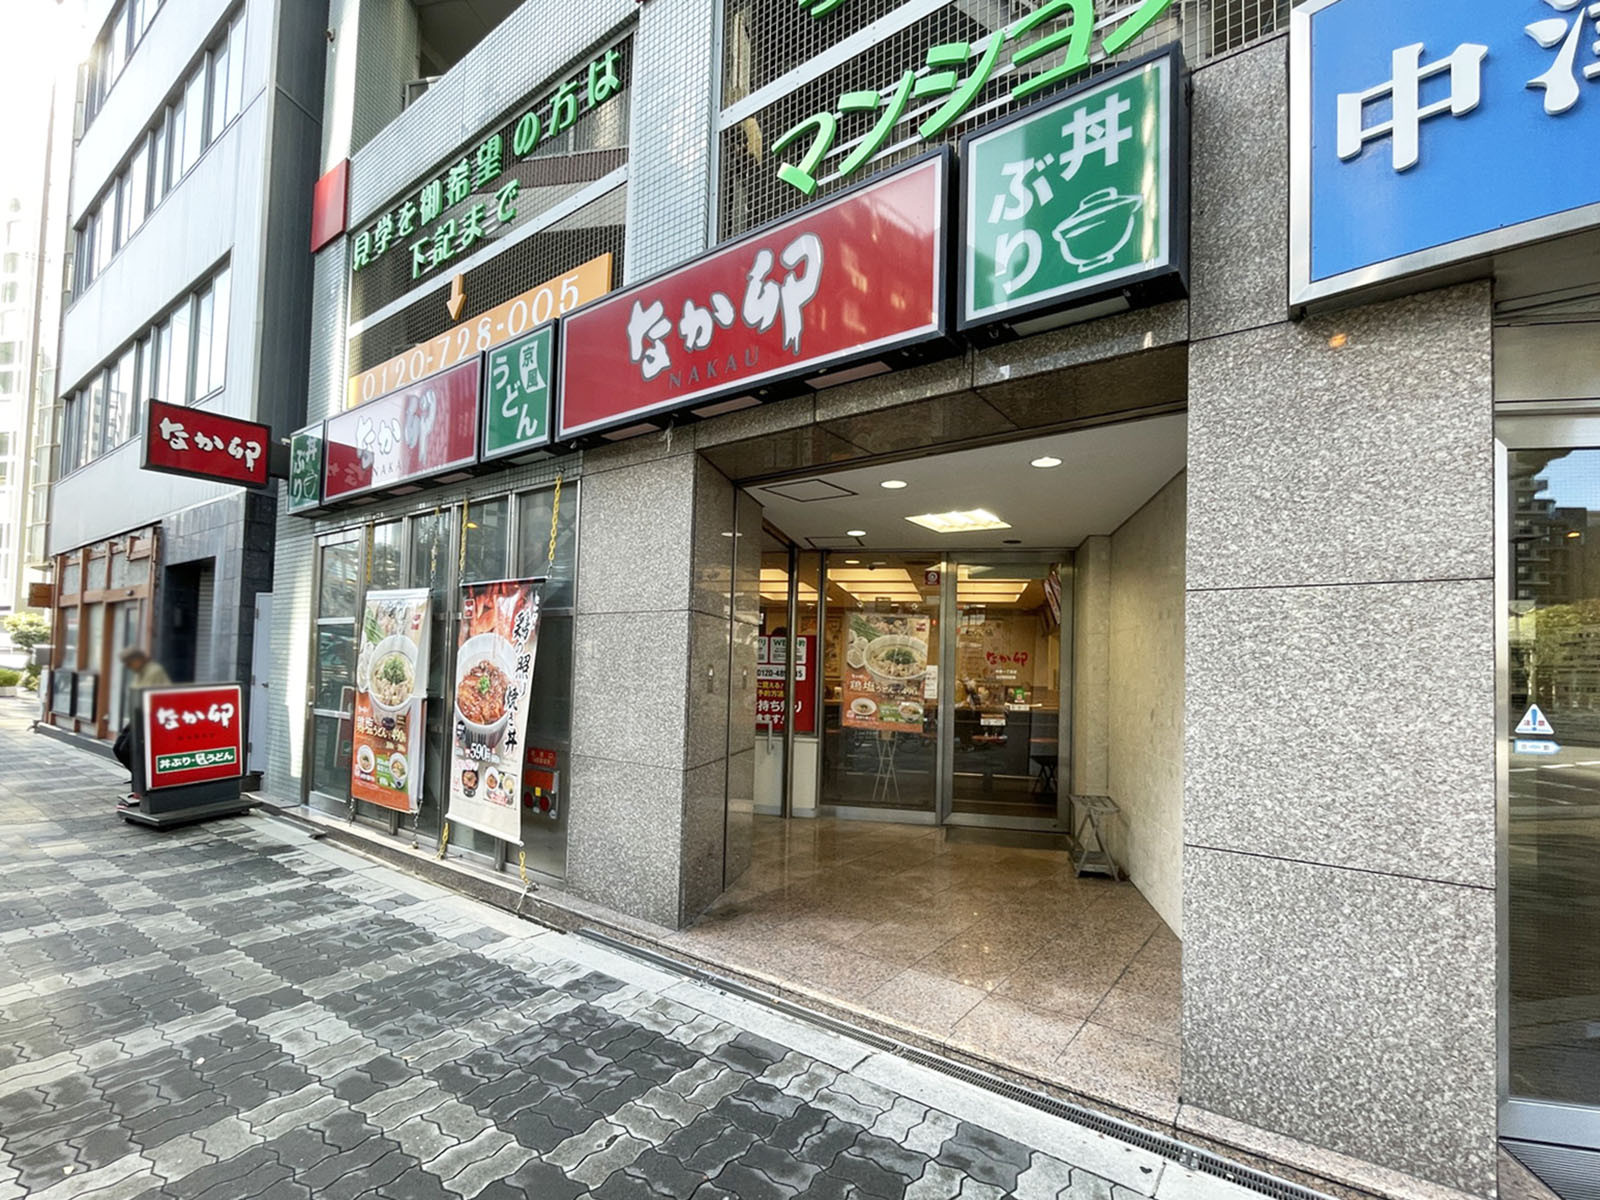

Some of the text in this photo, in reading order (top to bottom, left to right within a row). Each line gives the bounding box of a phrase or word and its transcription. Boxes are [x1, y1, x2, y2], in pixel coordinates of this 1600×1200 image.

[352, 49, 622, 271] 見学を御希望の方は
[409, 178, 520, 280] 下記まで
[362, 274, 580, 401] 0120-728-005
[627, 232, 824, 382] なか卯
[493, 355, 538, 440] うどん
[668, 345, 761, 390] NAKAU
[159, 416, 263, 473] なか卯
[355, 389, 437, 471] なか卯
[373, 459, 407, 477] NAKA
[156, 702, 234, 730] なか卯
[758, 699, 803, 713] 持ちり
[159, 752, 233, 769] 丼ぶり・うどん
